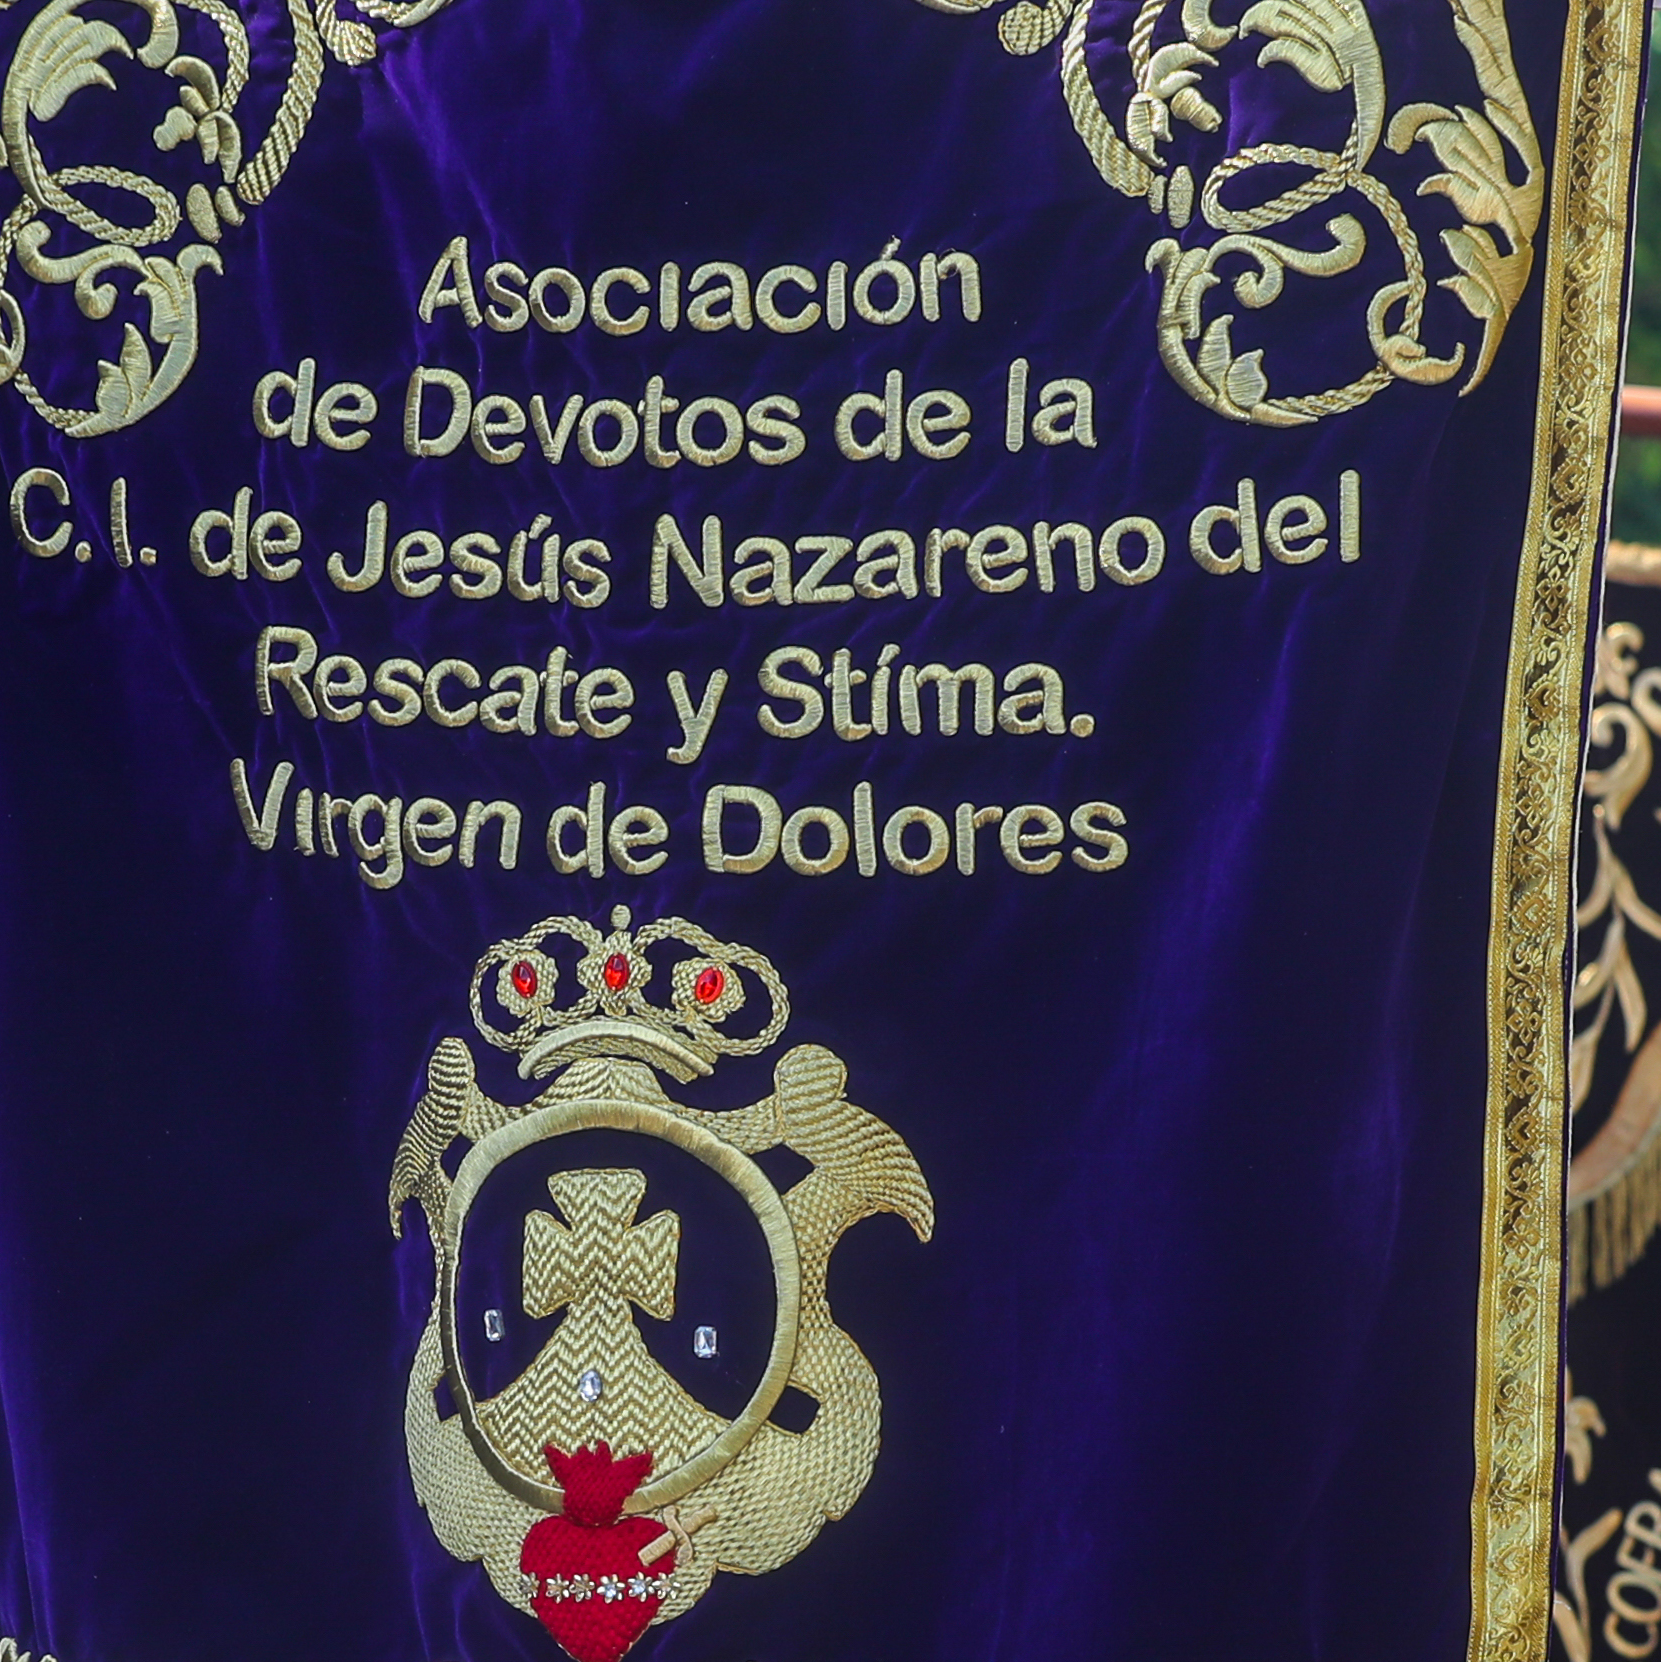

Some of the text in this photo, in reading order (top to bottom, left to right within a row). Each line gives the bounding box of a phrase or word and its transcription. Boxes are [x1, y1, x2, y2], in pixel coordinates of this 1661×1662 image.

[419, 235, 981, 335] Asociación
[253, 358, 1097, 468] de Devotos de la
[10, 468, 91, 562] C.
[189, 487, 302, 581] de
[327, 500, 611, 608] Jesús
[650, 514, 1165, 609] Nazareno
[1189, 470, 1360, 575] del
[256, 626, 1094, 764] Rescate y Stíma.
[231, 758, 1128, 889] Virgen de Dolores
